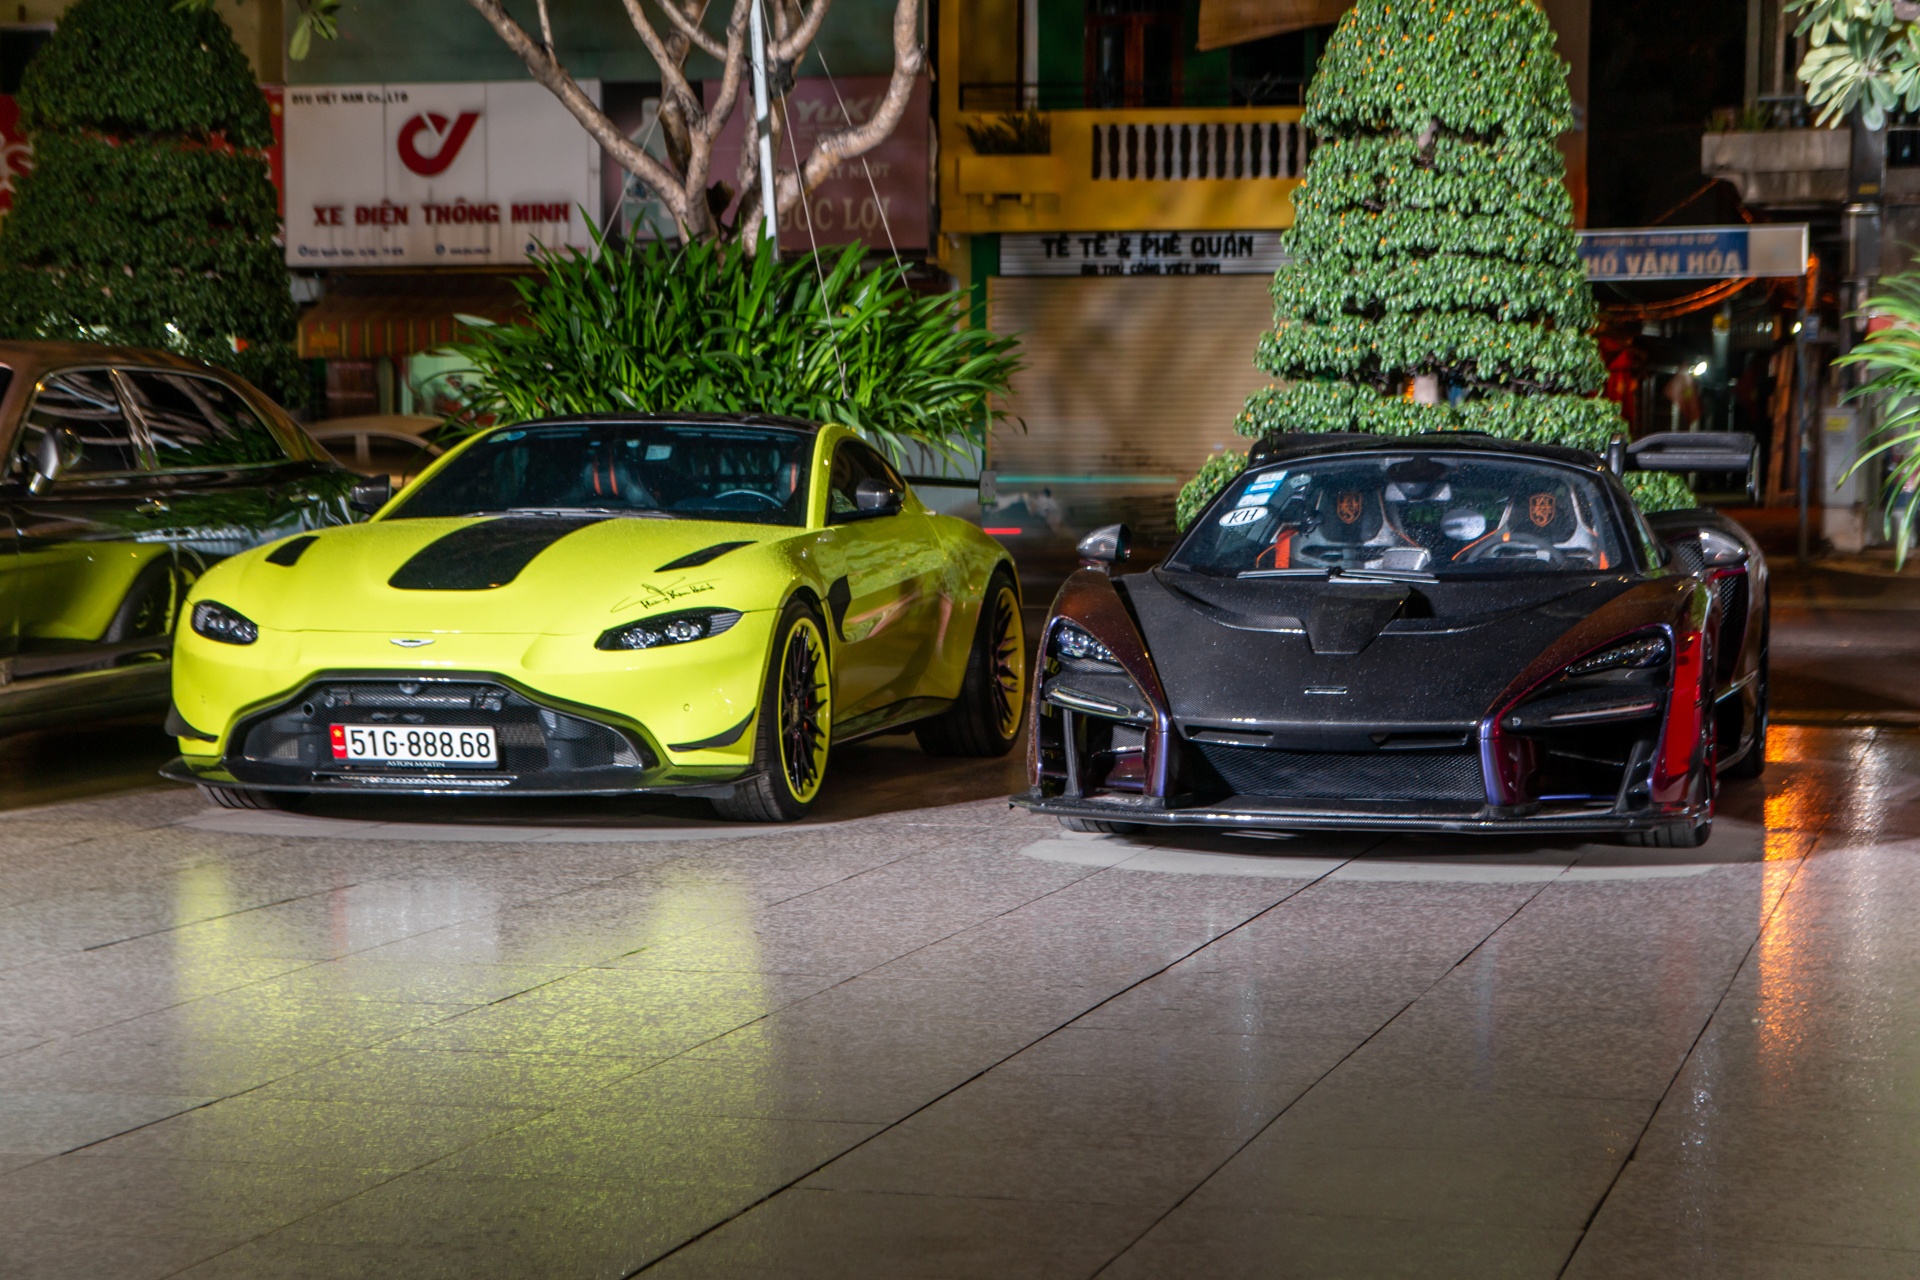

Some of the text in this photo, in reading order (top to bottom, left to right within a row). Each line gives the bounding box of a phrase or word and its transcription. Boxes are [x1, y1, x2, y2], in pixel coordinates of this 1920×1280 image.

[313, 197, 570, 232] XE ĐIỆN THÔNG MINH
[1041, 232, 1070, 258] TÊ
[1117, 236, 1131, 258] &
[1140, 232, 1182, 257] PHÊ
[1625, 248, 1680, 276] VĂN
[1687, 247, 1742, 275] HÓA
[1228, 509, 1258, 524] KH
[350, 729, 491, 758] 51G-888.68
